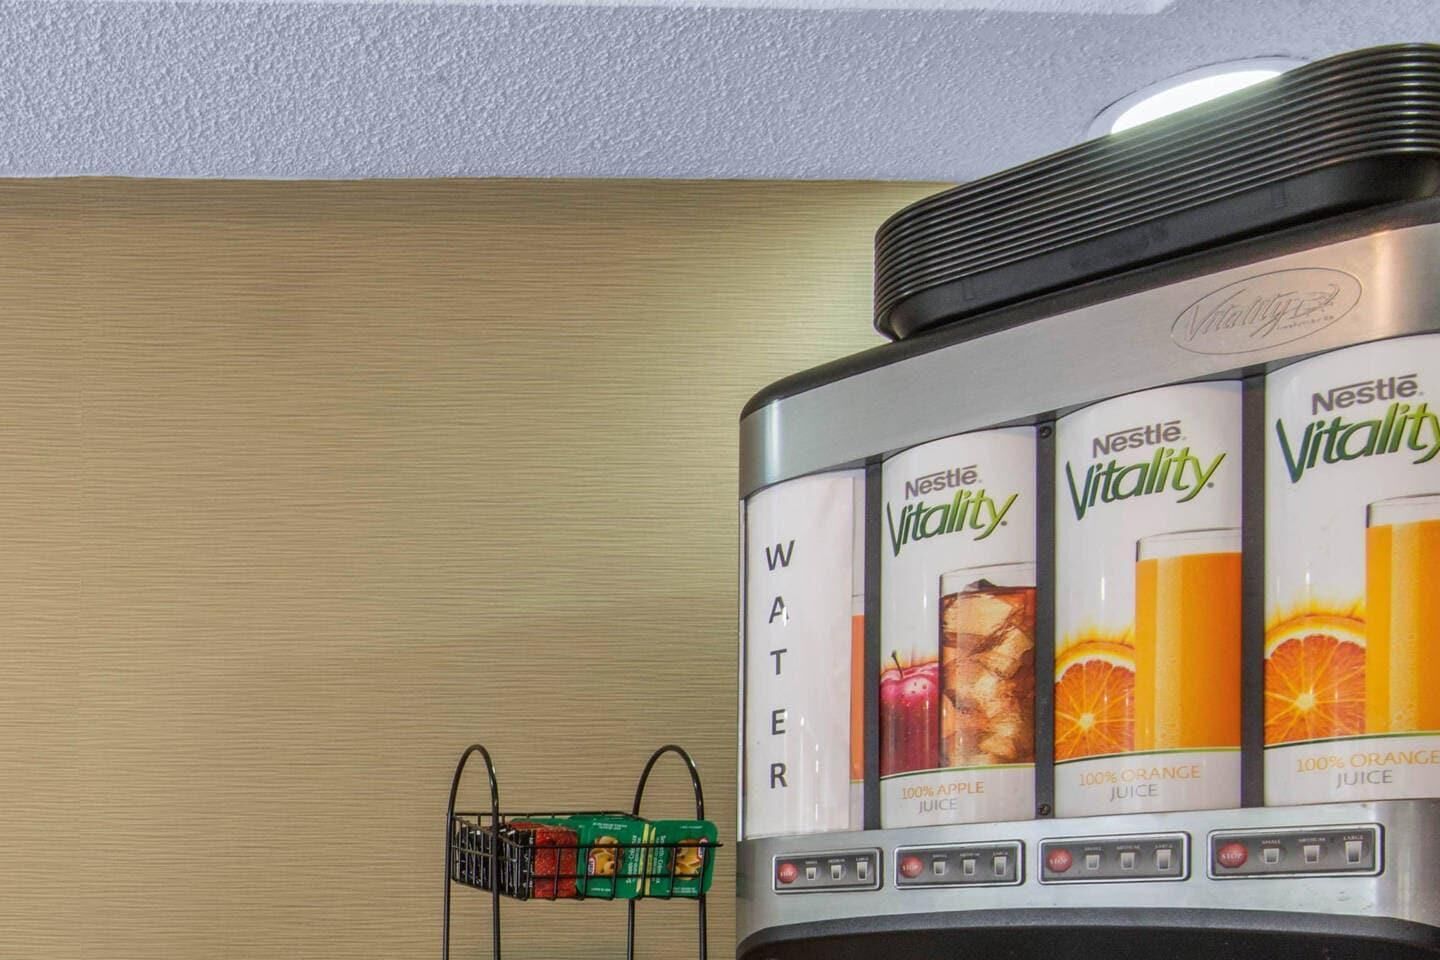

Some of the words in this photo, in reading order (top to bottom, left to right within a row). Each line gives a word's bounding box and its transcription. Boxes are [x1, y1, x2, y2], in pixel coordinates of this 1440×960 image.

[1275, 402, 1440, 484] Vitality
[1065, 446, 1227, 521] Vitality
[886, 488, 1019, 558] Vitality
[765, 539, 796, 790] WATER
[1296, 755, 1345, 773] 100%
[1349, 750, 1440, 768] ORANGE
[1079, 771, 1118, 787] 100%
[1120, 764, 1202, 782] ORANGE
[1336, 769, 1393, 789] JUICE
[902, 785, 935, 800] 100%
[936, 781, 985, 796] APPLE
[1110, 783, 1159, 802] JUICE
[918, 798, 958, 815] JUICE
